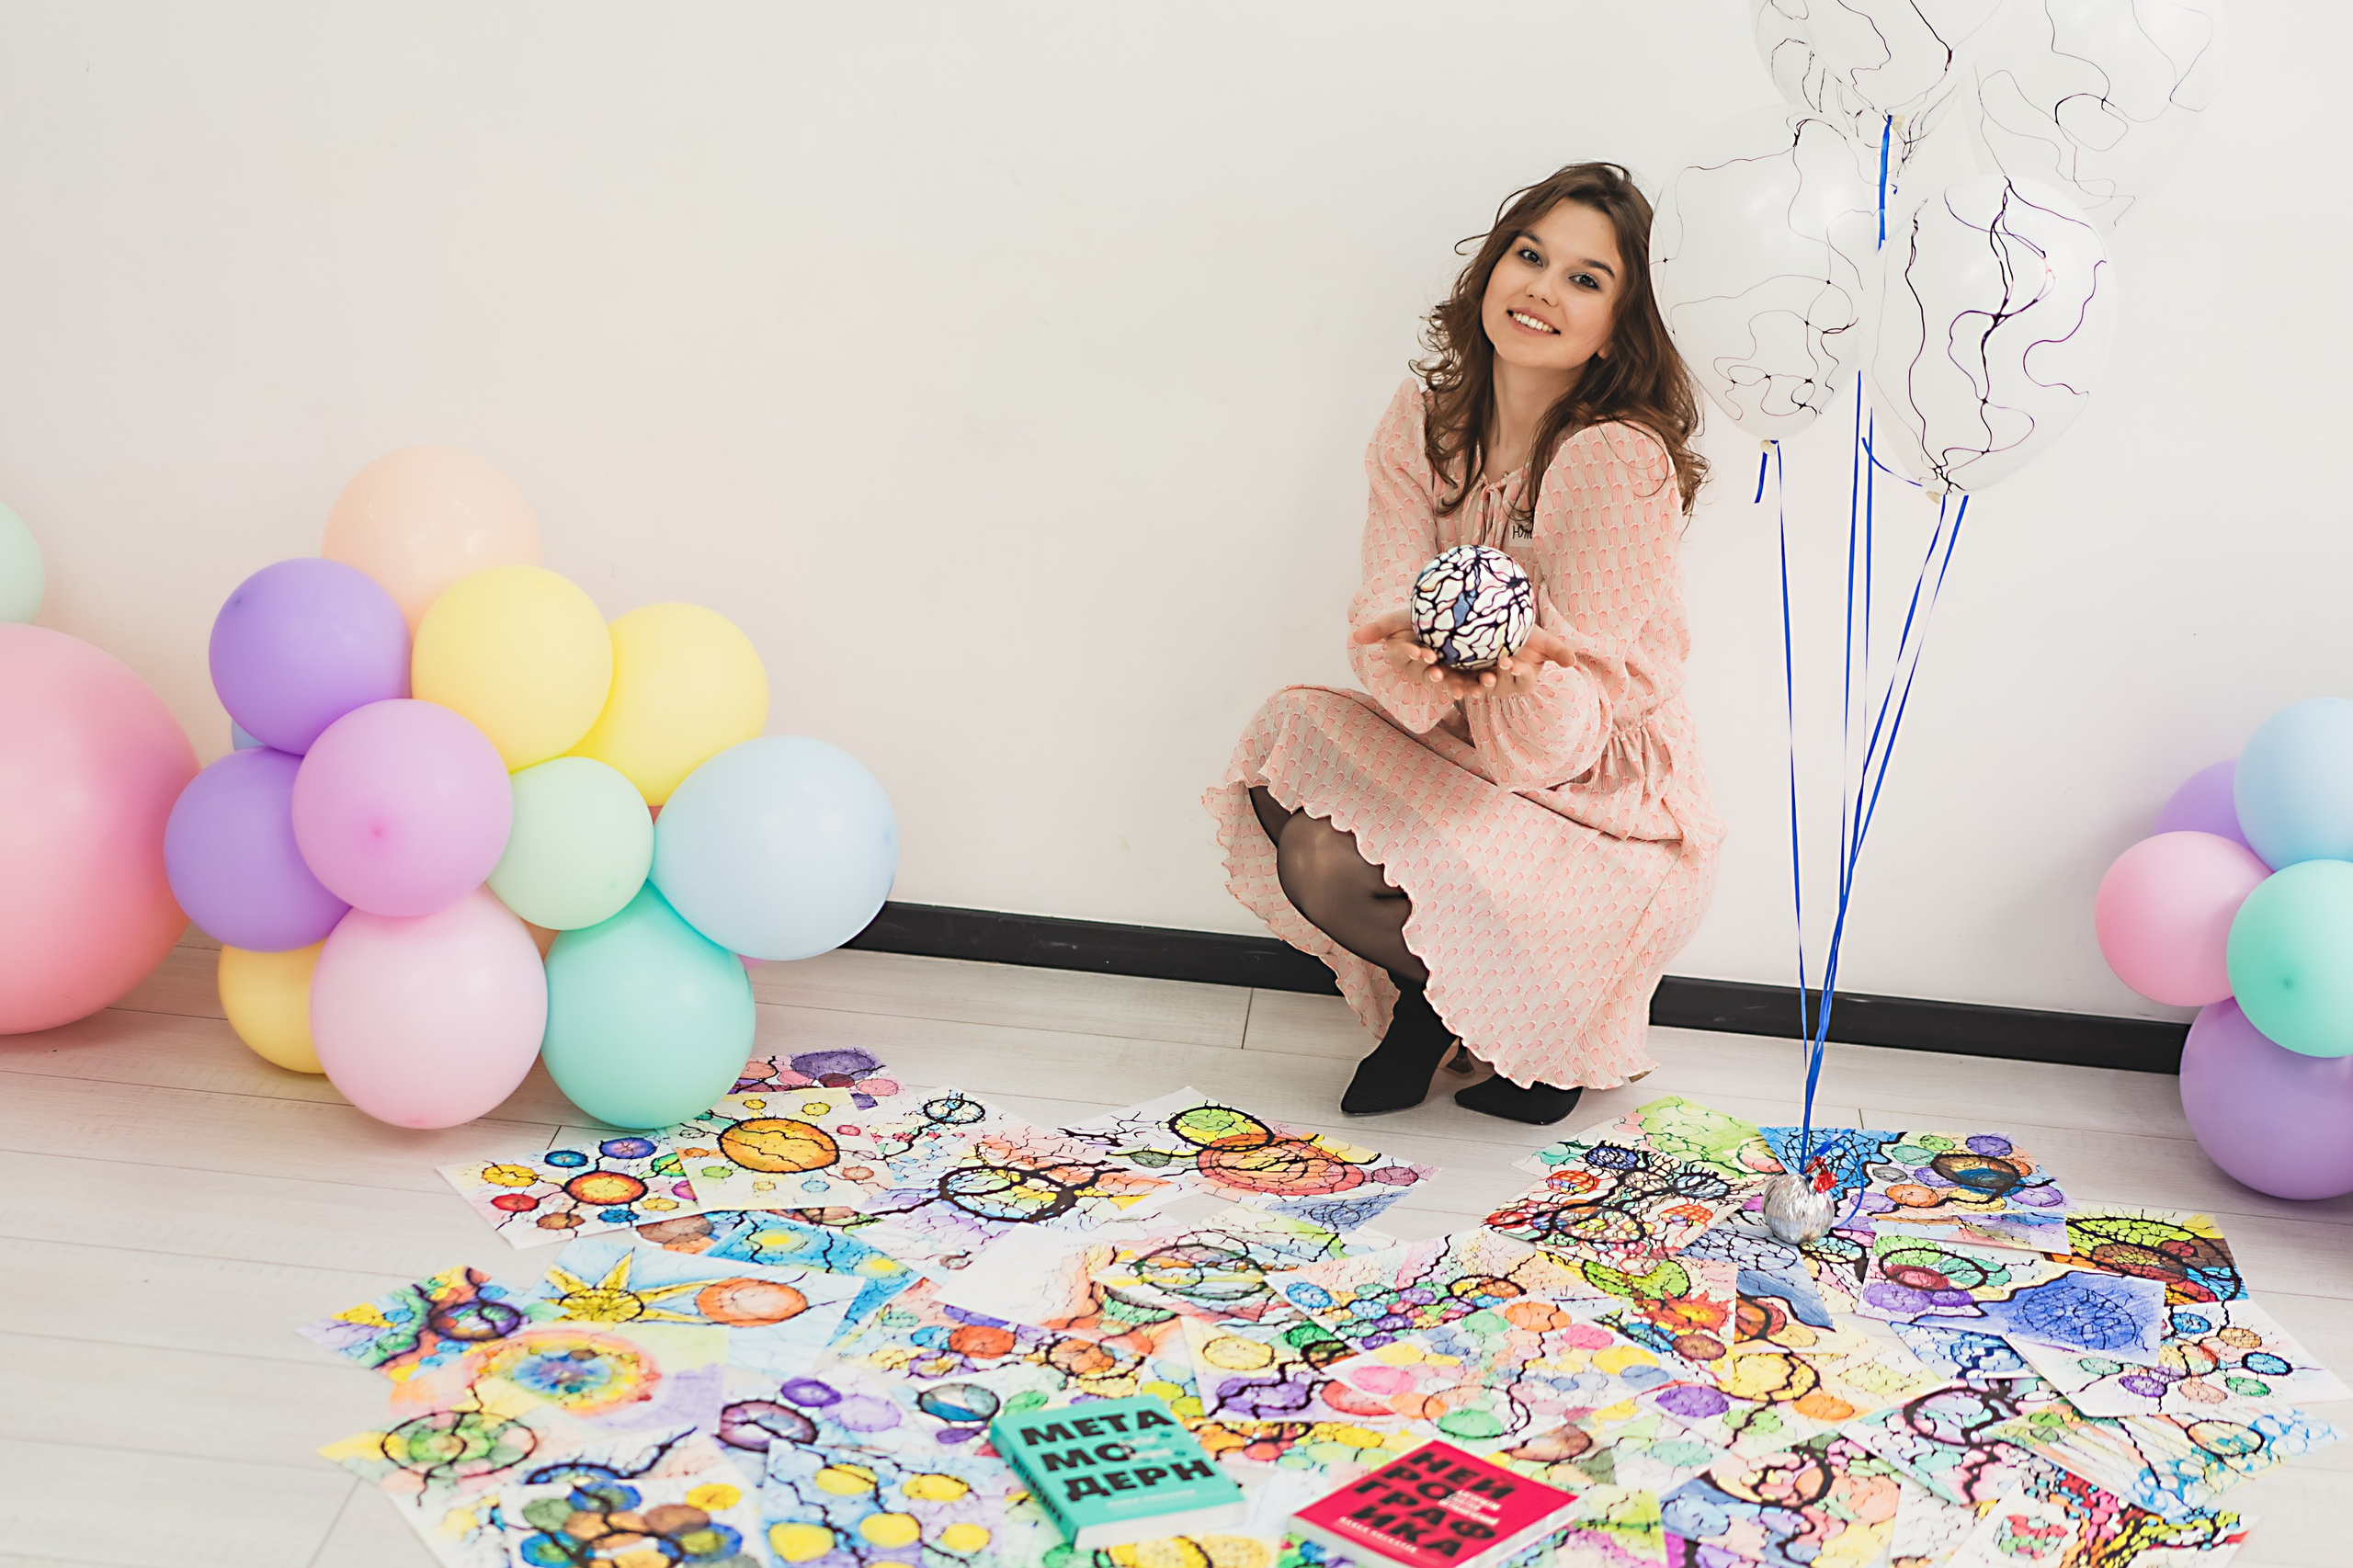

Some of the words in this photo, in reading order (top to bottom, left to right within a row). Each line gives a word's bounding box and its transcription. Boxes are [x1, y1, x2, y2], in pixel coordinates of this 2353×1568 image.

[1020, 1409, 1176, 1446] МЕТА
[1063, 1460, 1214, 1502] ДЕРН
[1382, 1466, 1456, 1500] РО
[1409, 1451, 1515, 1499] НЕЙ
[1351, 1506, 1463, 1557] ИКА
[1353, 1481, 1495, 1540] ГРАФ
